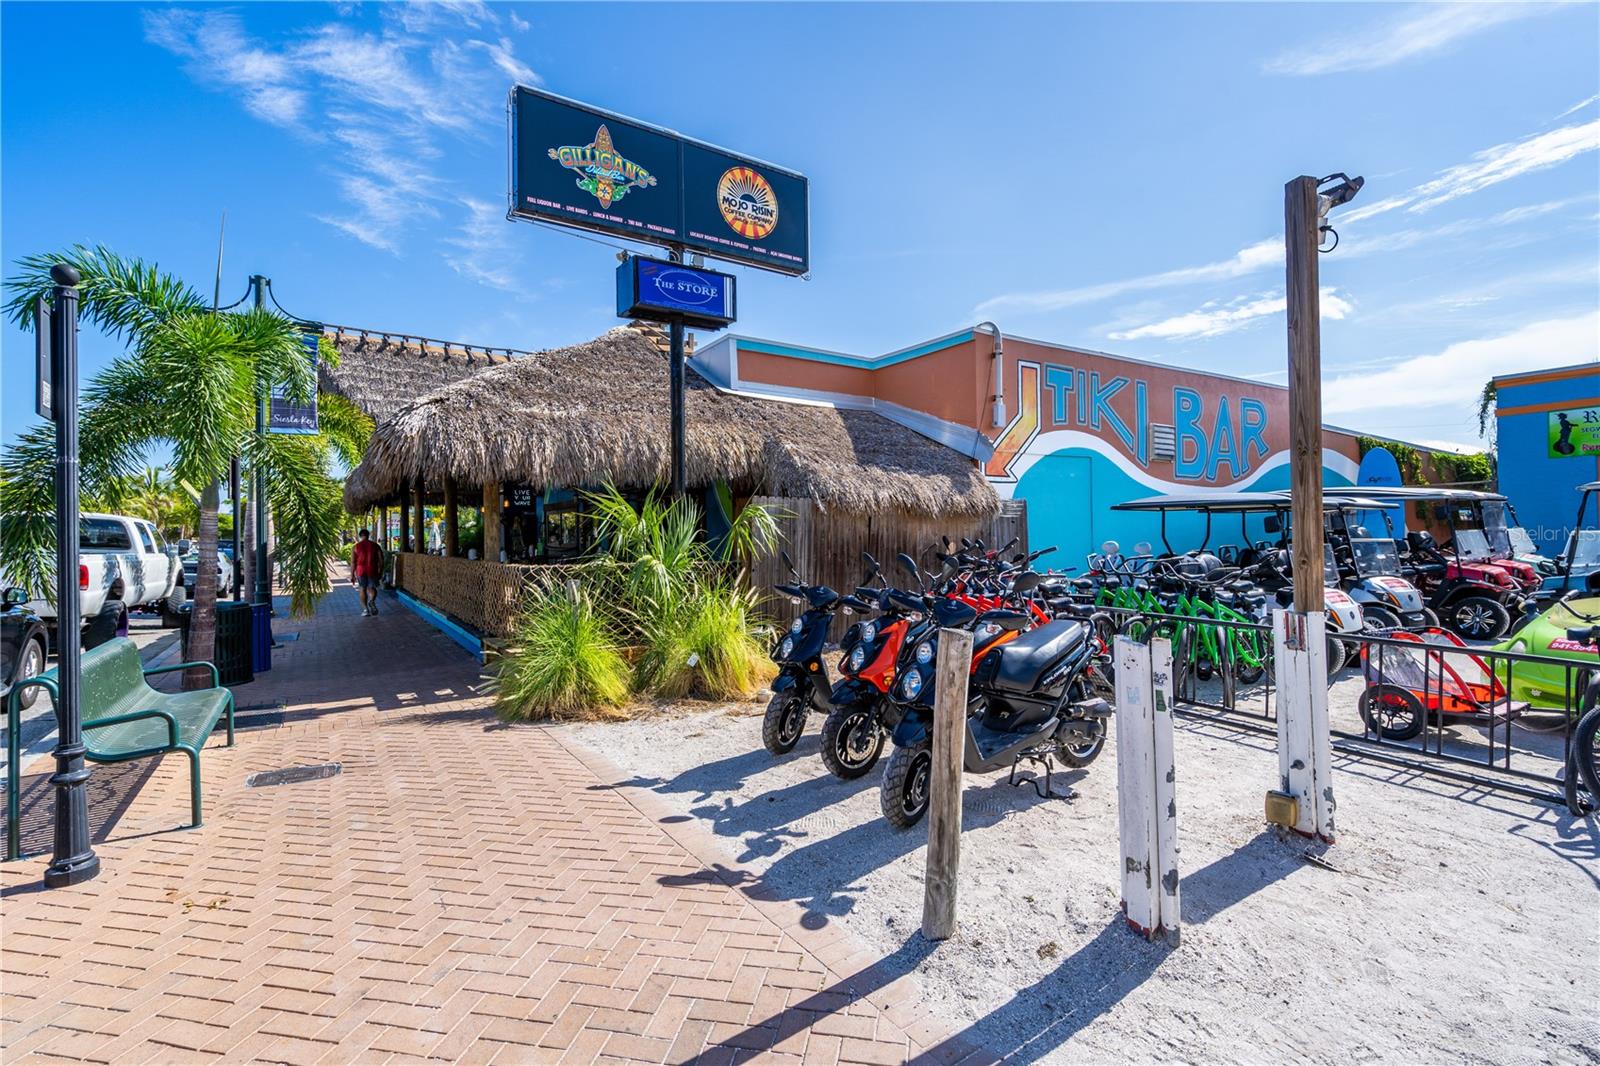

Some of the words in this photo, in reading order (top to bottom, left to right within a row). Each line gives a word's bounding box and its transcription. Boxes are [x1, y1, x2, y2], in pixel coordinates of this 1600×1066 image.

[559, 147, 649, 187] GILLIGAN'S
[552, 201, 561, 209] BAR
[722, 195, 749, 210] MOJO
[723, 206, 746, 217] COFFEE
[747, 213, 773, 225] COMPANY
[677, 281, 718, 297] STORE
[273, 413, 300, 423] Siesta
[300, 415, 315, 428] Key
[1044, 362, 1148, 468] TIKI
[1173, 385, 1269, 483] BAR
